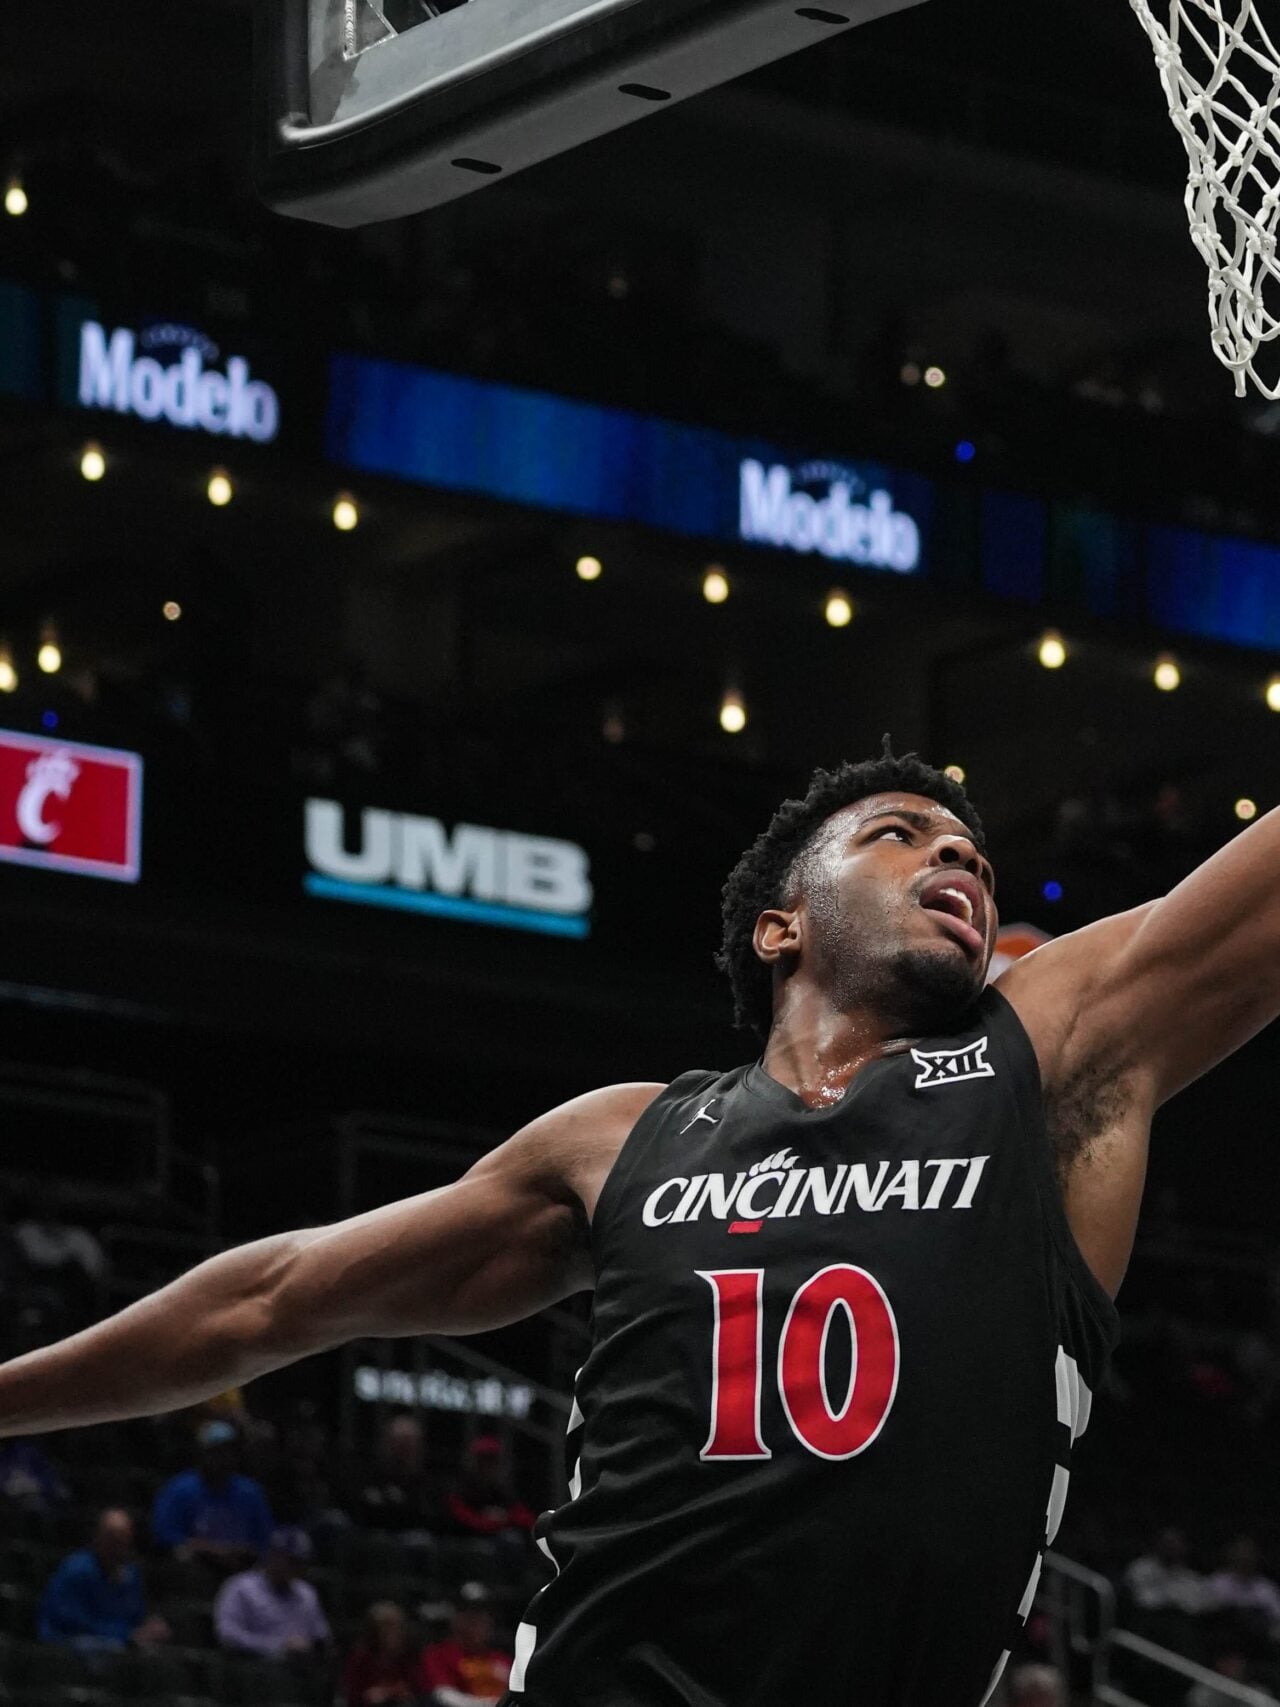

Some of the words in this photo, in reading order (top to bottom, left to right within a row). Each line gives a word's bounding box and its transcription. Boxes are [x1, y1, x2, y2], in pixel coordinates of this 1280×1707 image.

[80, 320, 279, 444] Modelo
[739, 457, 920, 575] Modelo
[304, 798, 593, 915] UMB
[642, 1149, 991, 1228] CINCINNATI
[693, 1262, 901, 1462] 10
